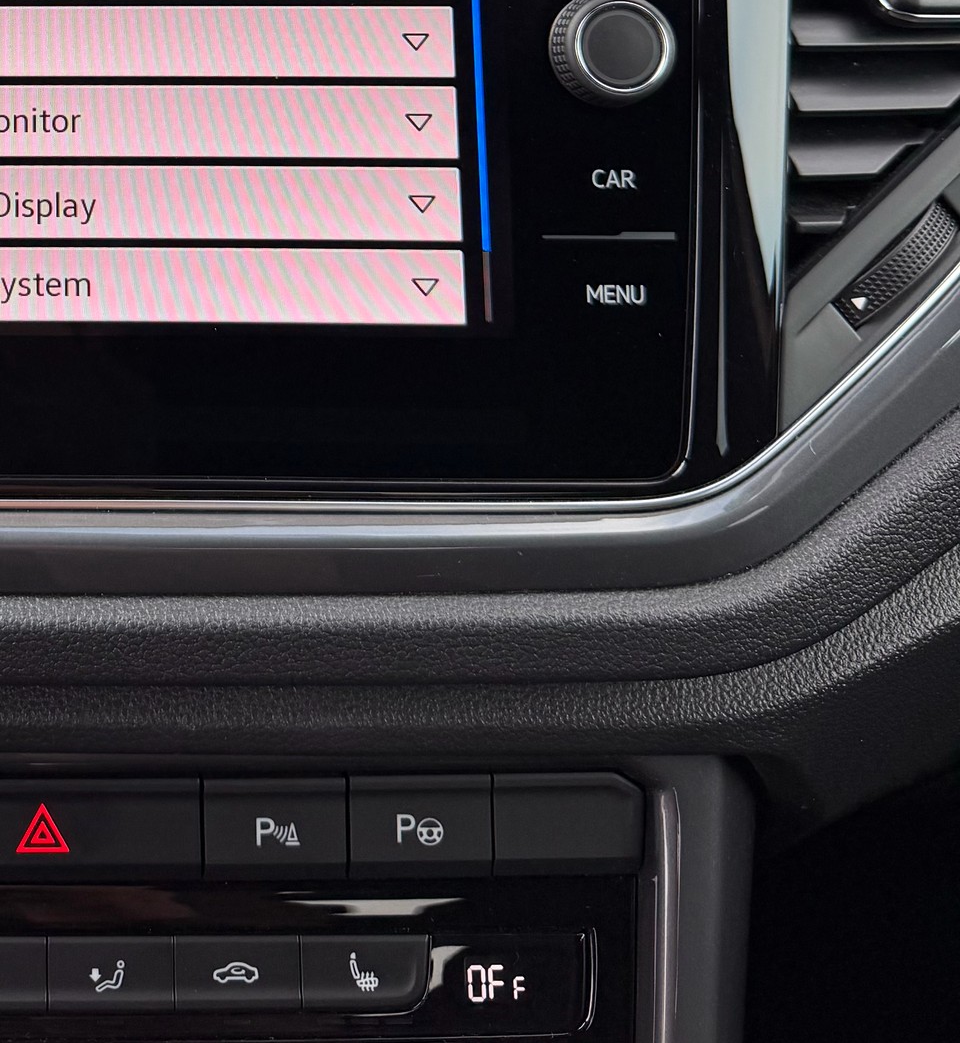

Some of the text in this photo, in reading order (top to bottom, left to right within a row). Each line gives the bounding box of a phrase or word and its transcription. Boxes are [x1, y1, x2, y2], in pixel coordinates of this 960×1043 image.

[591, 168, 636, 189] CAR
[586, 284, 645, 305] MENU
[255, 817, 276, 847] P
[396, 813, 416, 844] P
